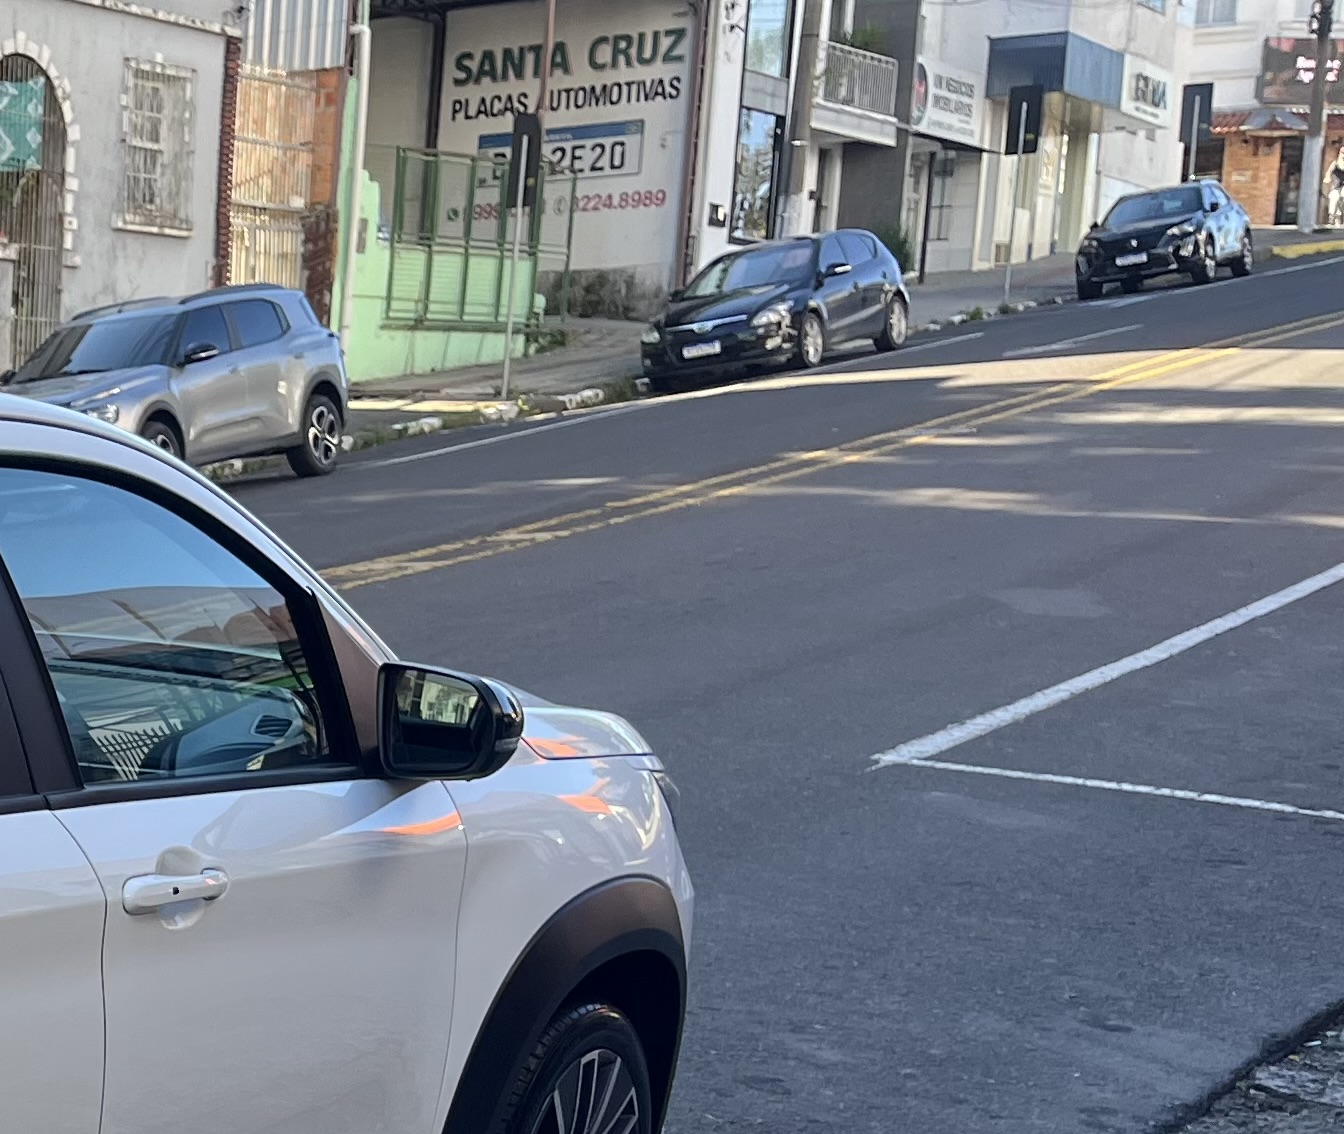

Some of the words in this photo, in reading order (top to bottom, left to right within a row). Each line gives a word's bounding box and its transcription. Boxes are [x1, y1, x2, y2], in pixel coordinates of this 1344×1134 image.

[452, 40, 571, 87] SANTA
[588, 28, 688, 72] CRUZ
[452, 93, 529, 121] PLACAS
